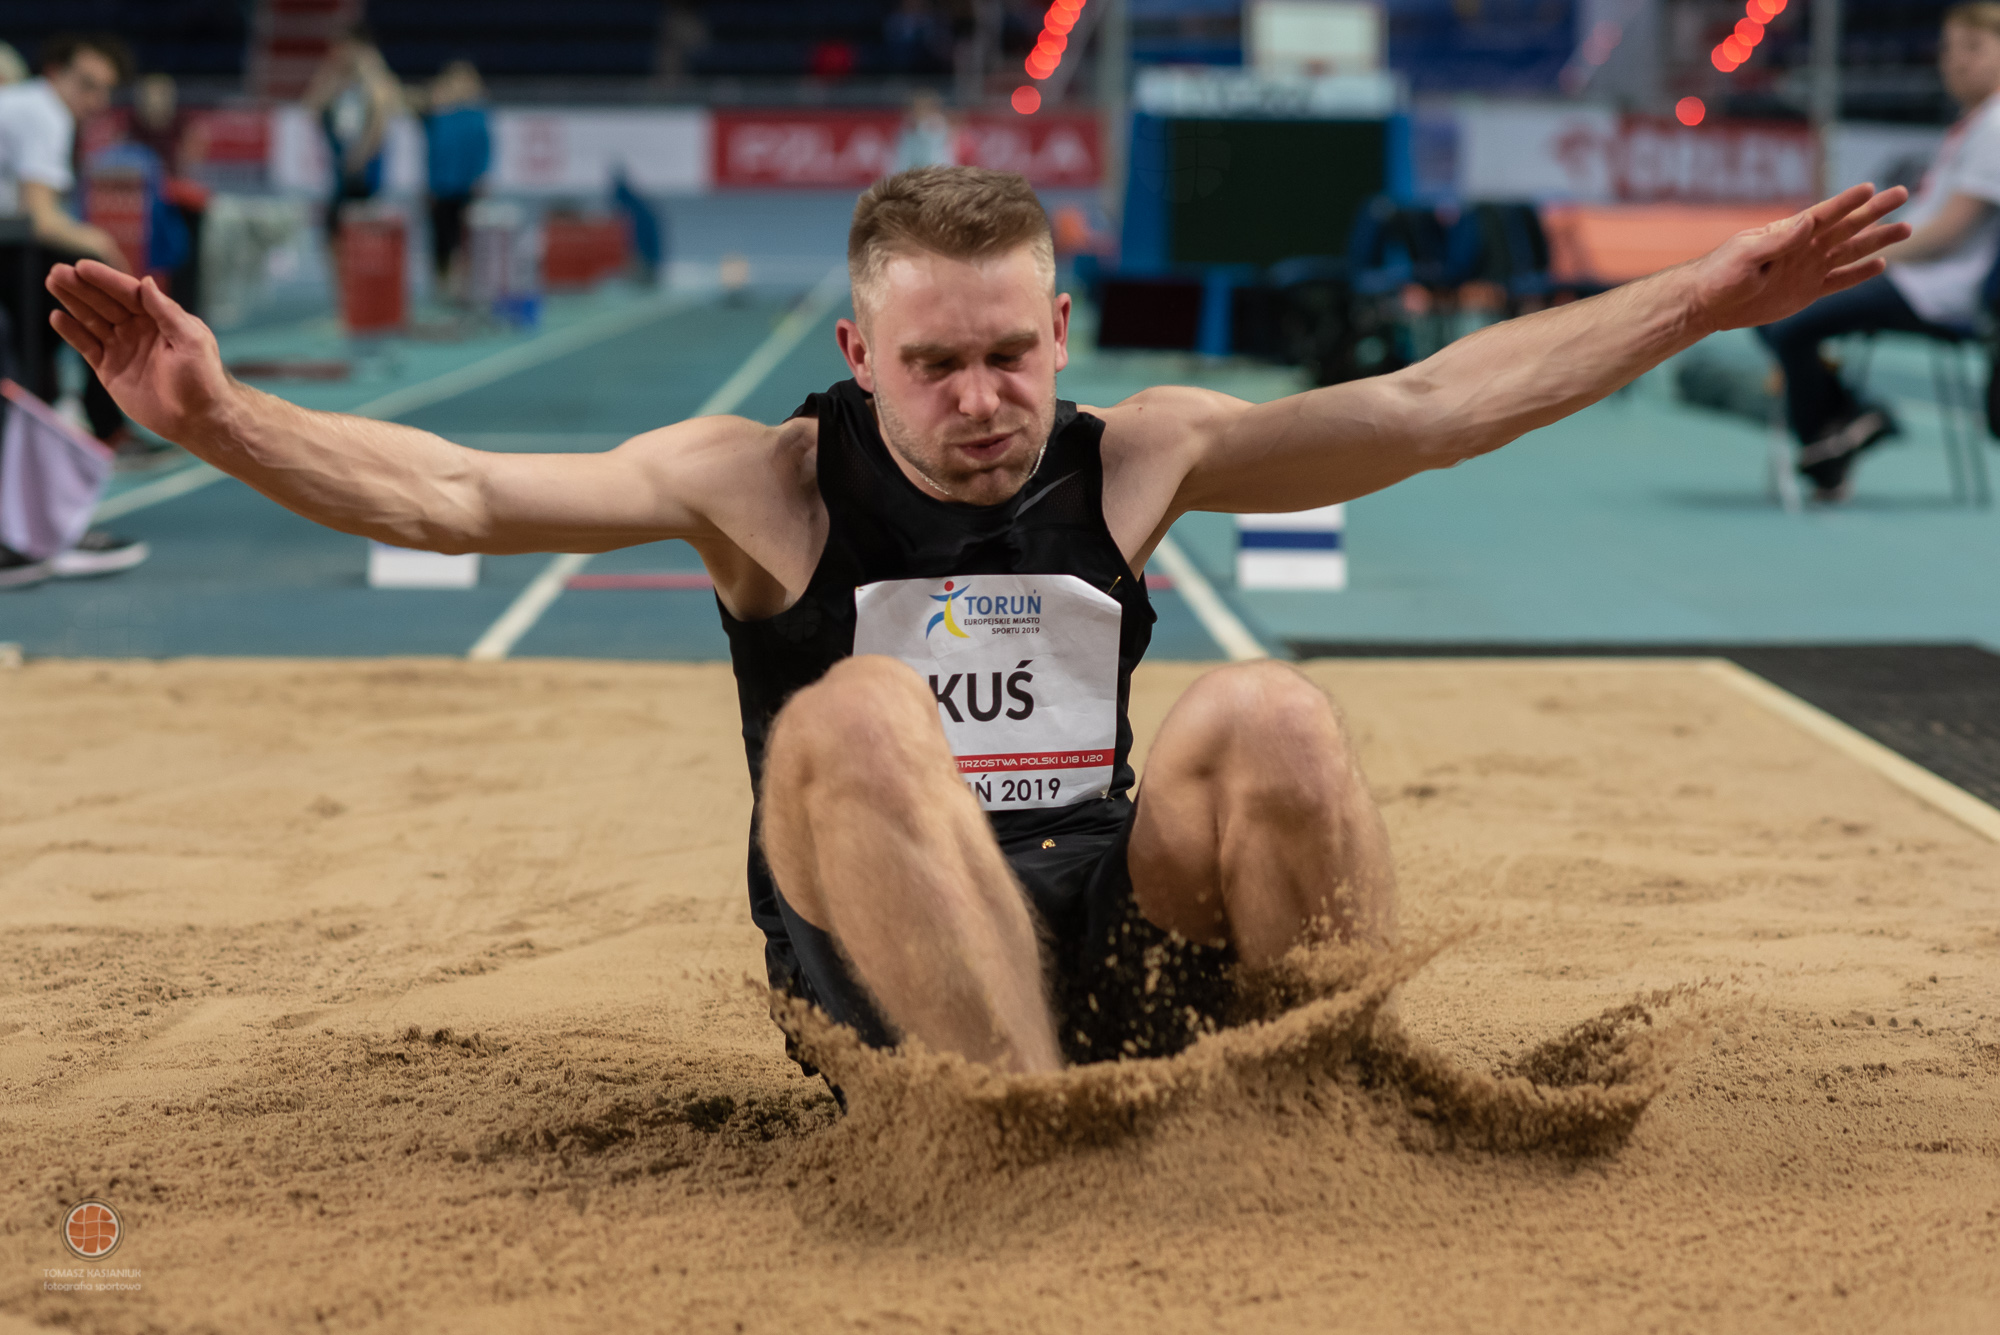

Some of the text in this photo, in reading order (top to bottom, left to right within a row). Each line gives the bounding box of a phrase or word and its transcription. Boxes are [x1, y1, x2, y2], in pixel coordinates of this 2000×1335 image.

[964, 589, 1041, 615] TORUŃ
[964, 616, 1040, 626] EUROPEJSKIE MIASTO
[991, 626, 1040, 635] SPORTU 2019
[928, 659, 1034, 723] KUŚ
[1019, 756, 1059, 766] POLSKI
[1060, 755, 1080, 764] U18
[1081, 754, 1104, 763] U20
[1001, 777, 1061, 802] 2019
